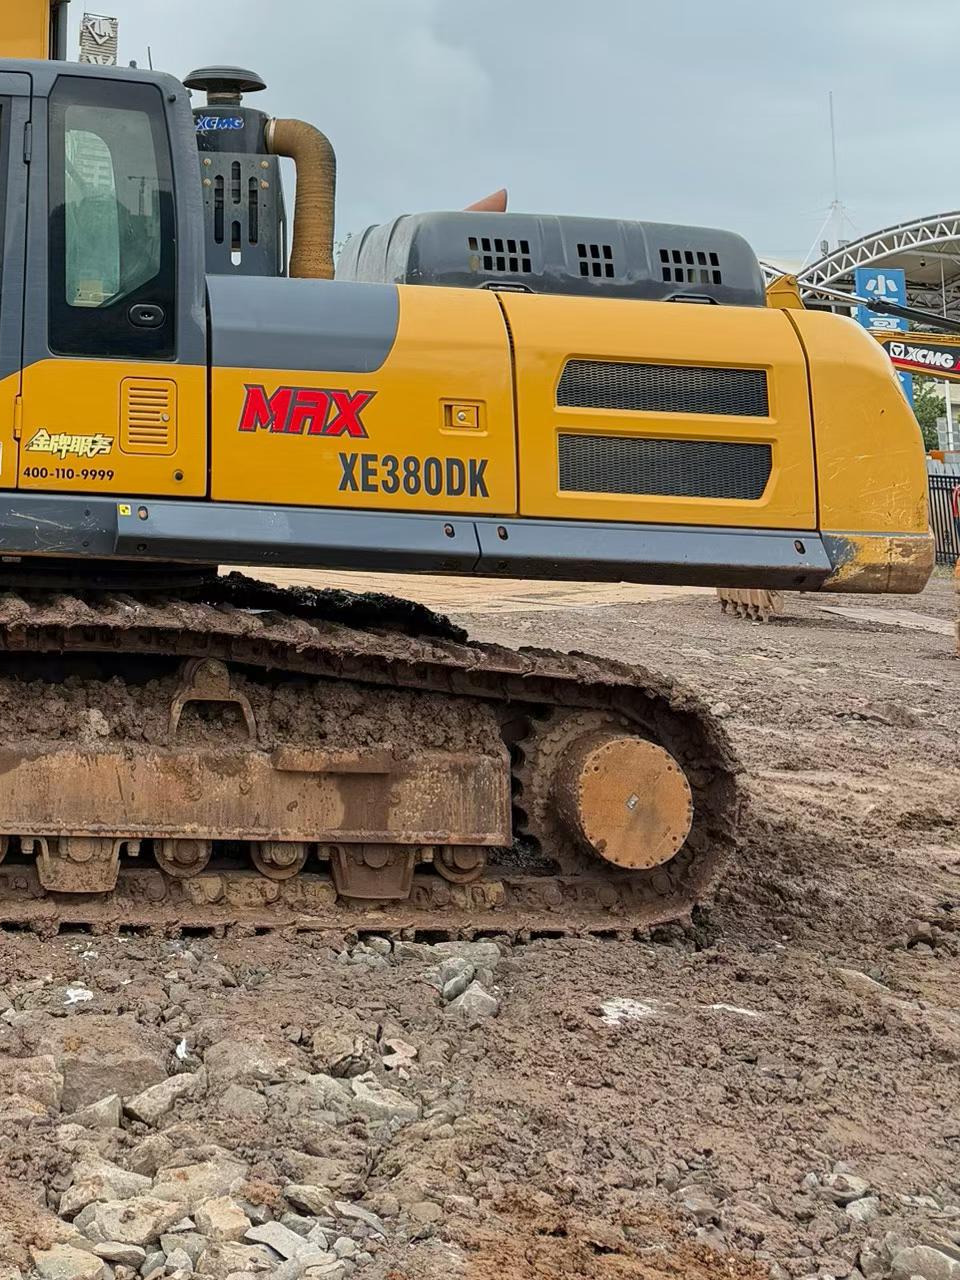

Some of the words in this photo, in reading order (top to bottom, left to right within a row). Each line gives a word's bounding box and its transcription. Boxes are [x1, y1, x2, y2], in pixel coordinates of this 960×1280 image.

[905, 346, 955, 369] XCMG
[238, 383, 377, 439] MAX
[24, 428, 114, 460] 金牌服务
[22, 466, 115, 481] 400-110-9999
[338, 452, 490, 498] XE380DK
